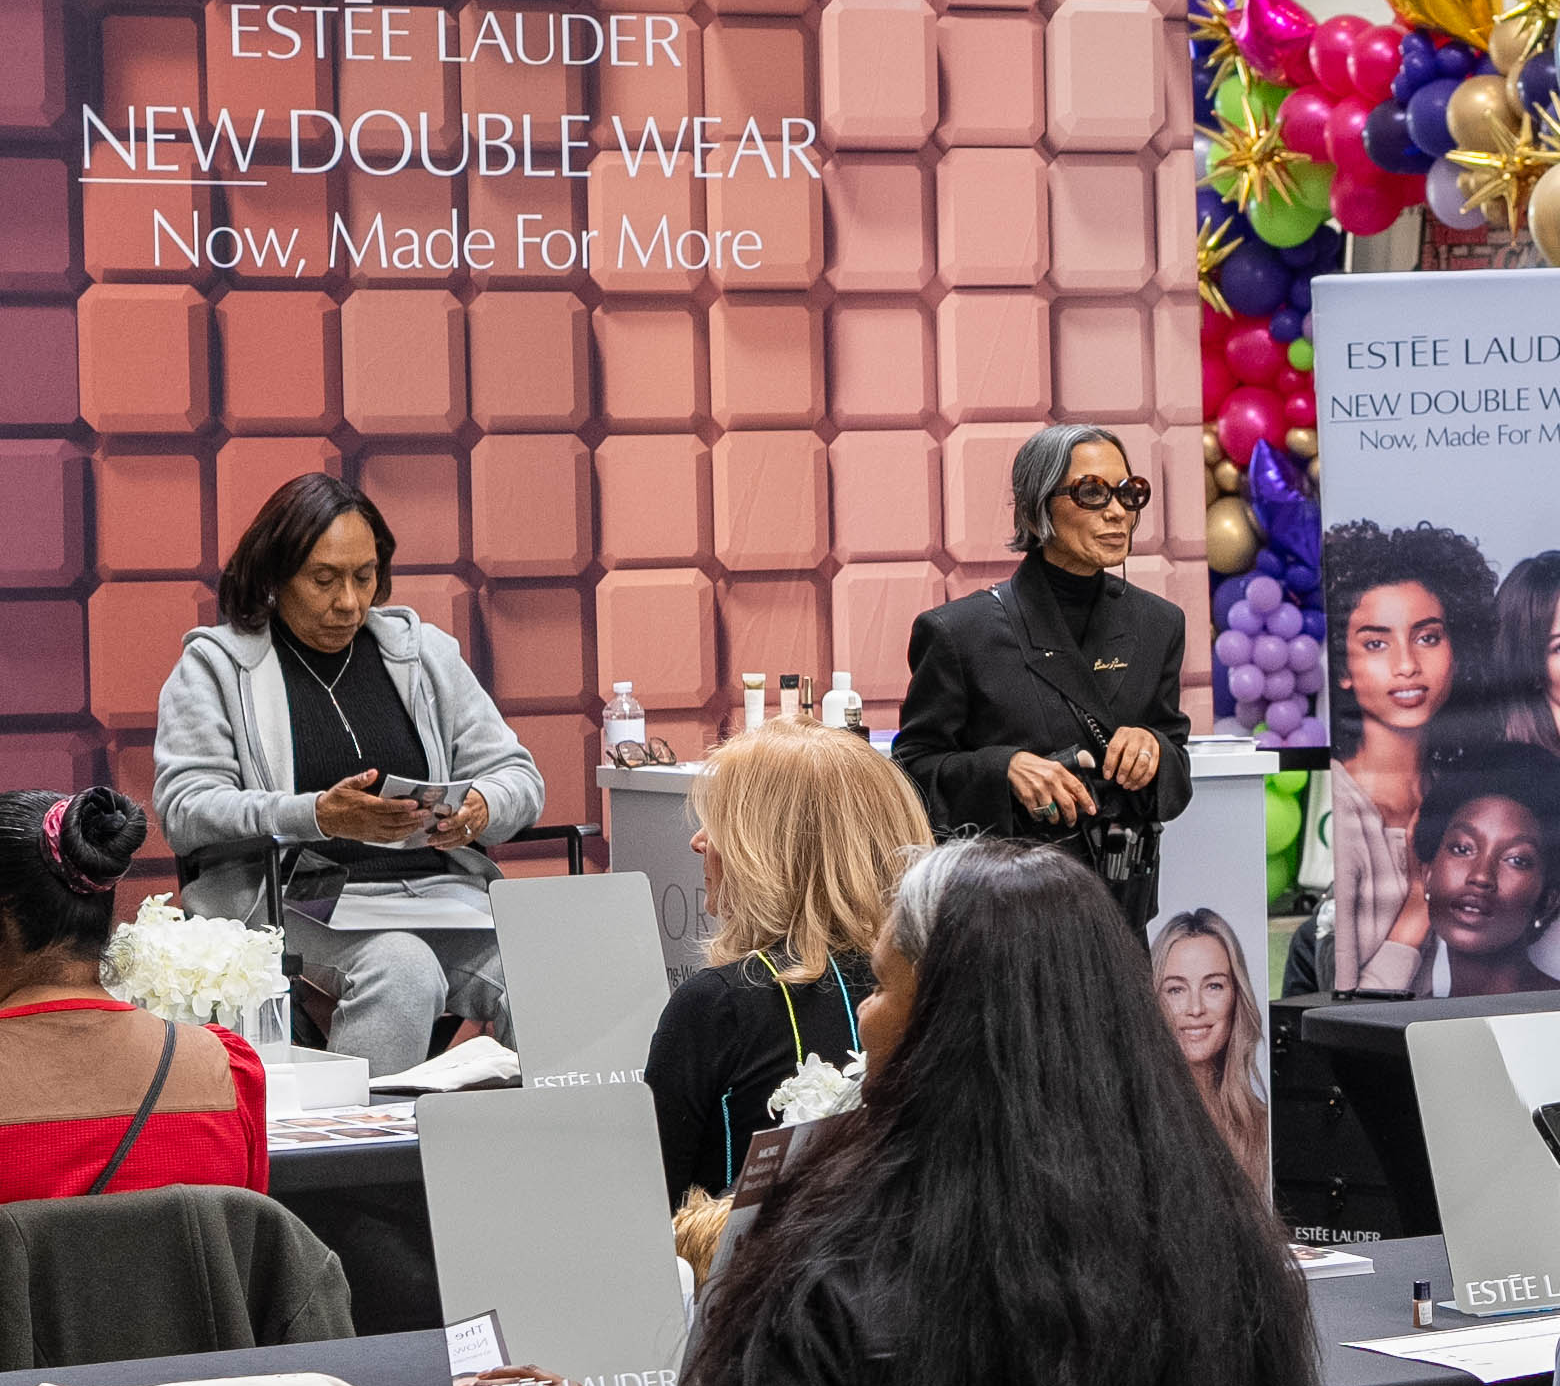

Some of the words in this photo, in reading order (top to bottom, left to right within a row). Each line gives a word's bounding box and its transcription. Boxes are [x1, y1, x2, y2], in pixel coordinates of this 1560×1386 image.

[437, 9, 682, 68] LAUDER
[79, 102, 267, 176] NEW
[289, 108, 591, 179] DOUBLE
[612, 115, 824, 180] WEAR
[152, 208, 309, 278] Now,
[328, 208, 496, 270] Made
[517, 212, 598, 270] For
[617, 213, 764, 270] More
[1330, 391, 1403, 420] NEW
[1410, 387, 1530, 415] DOUBLE
[1359, 428, 1418, 452] Now,
[1424, 424, 1491, 449] Made
[1497, 424, 1533, 445] For
[1332, 1229, 1382, 1243] LAUDER
